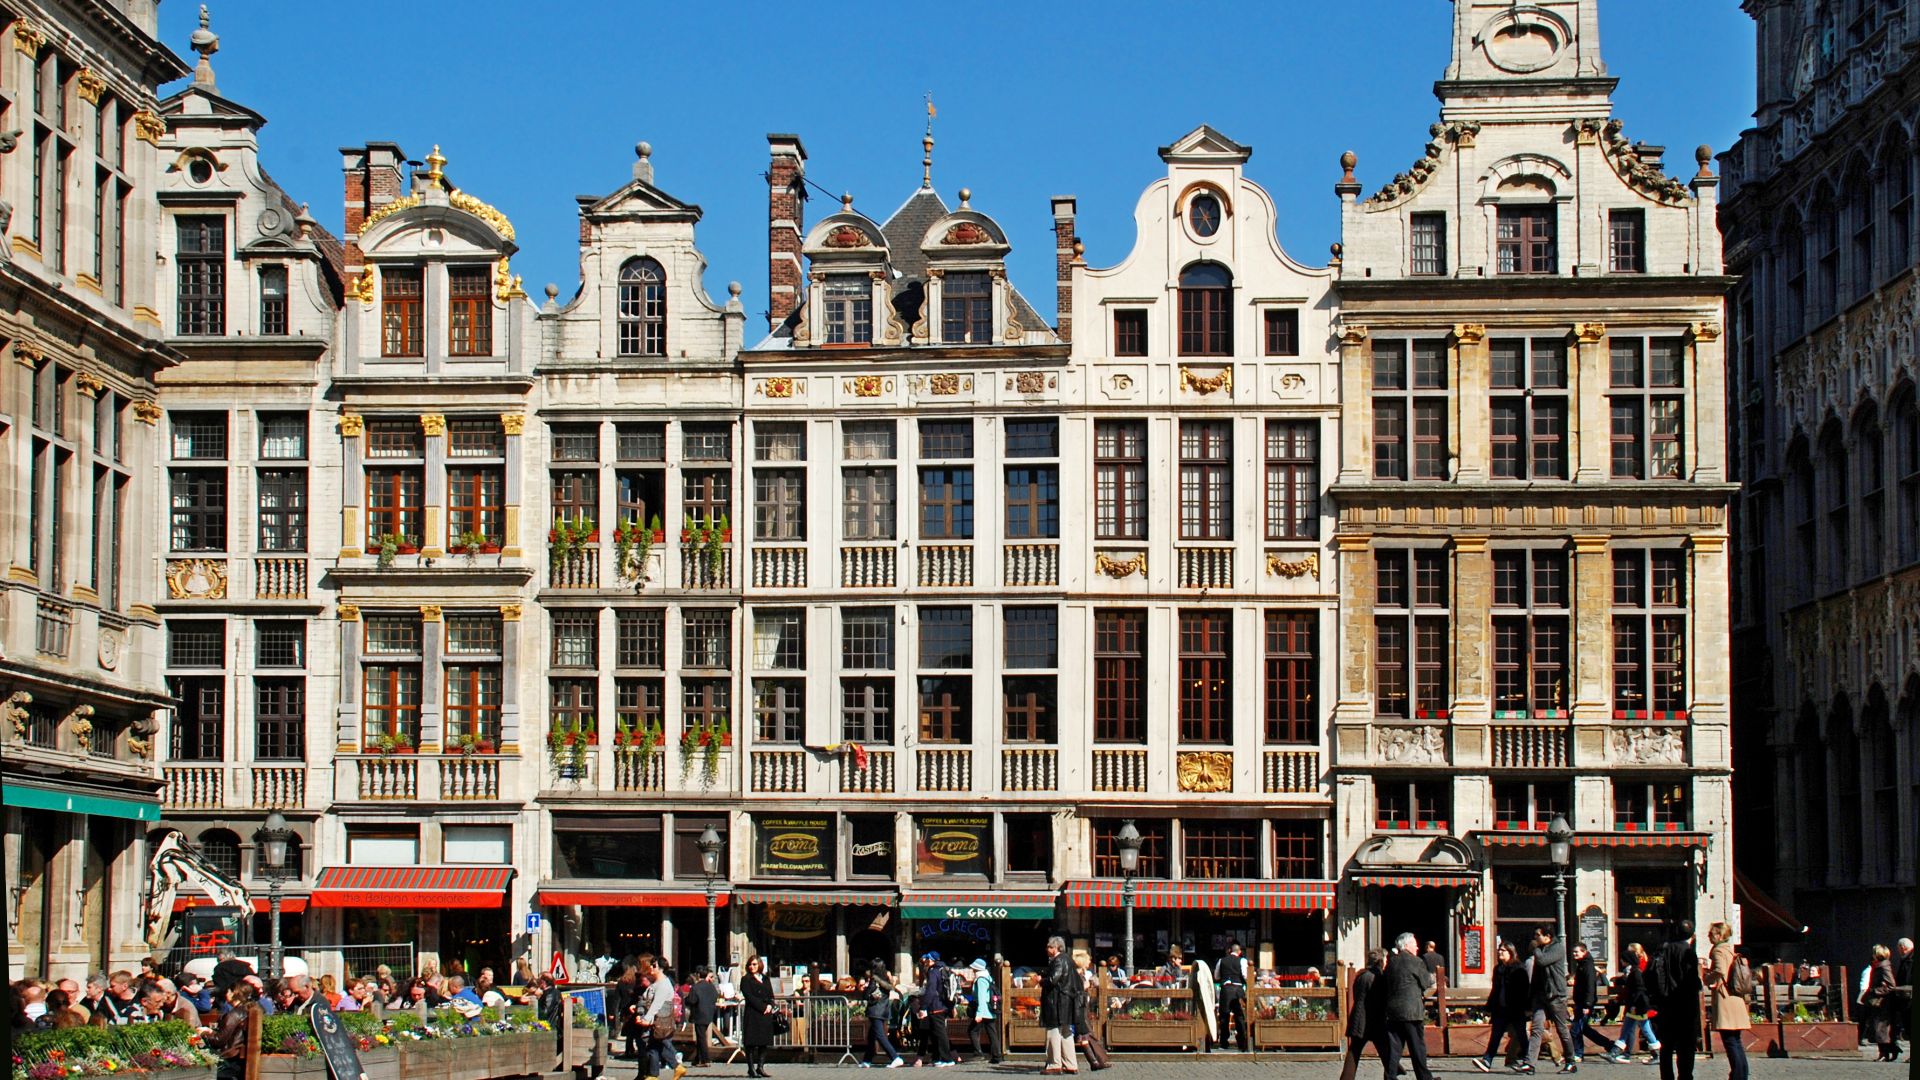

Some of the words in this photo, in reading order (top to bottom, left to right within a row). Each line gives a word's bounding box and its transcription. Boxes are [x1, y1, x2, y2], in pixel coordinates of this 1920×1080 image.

[754, 383, 763, 395] A
[796, 382, 806, 395] N
[842, 382, 852, 394] N
[1113, 377, 1127, 390] 16
[1282, 376, 1301, 390] 97
[770, 839, 819, 853] aroma
[930, 839, 979, 852] aroma
[343, 893, 360, 903] the
[365, 893, 408, 905] Belgian
[413, 893, 472, 904] chocolates
[946, 907, 961, 917] EL
[967, 907, 1008, 917] GRECO
[921, 923, 936, 938] EL
[939, 919, 988, 940] GRECO
